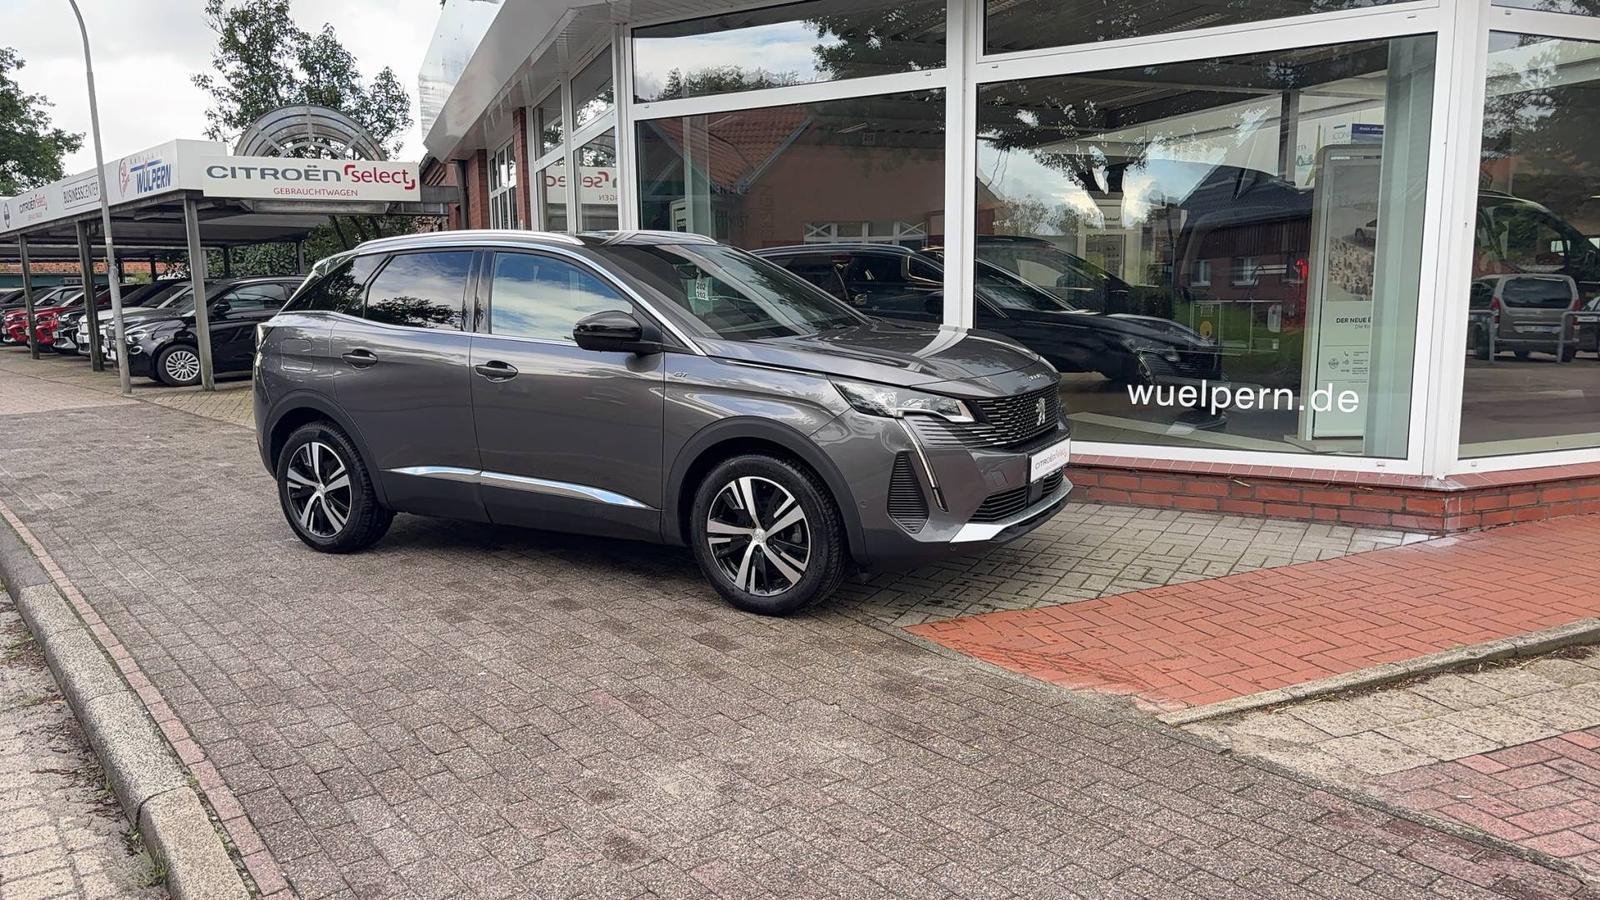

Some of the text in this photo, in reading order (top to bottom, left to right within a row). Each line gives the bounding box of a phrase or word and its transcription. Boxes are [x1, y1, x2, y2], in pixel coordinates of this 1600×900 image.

[206, 165, 410, 185] CITROËN select
[273, 187, 358, 197] GEBRAUCHTWAGEN
[1127, 379, 1360, 416] wuelpern.de
